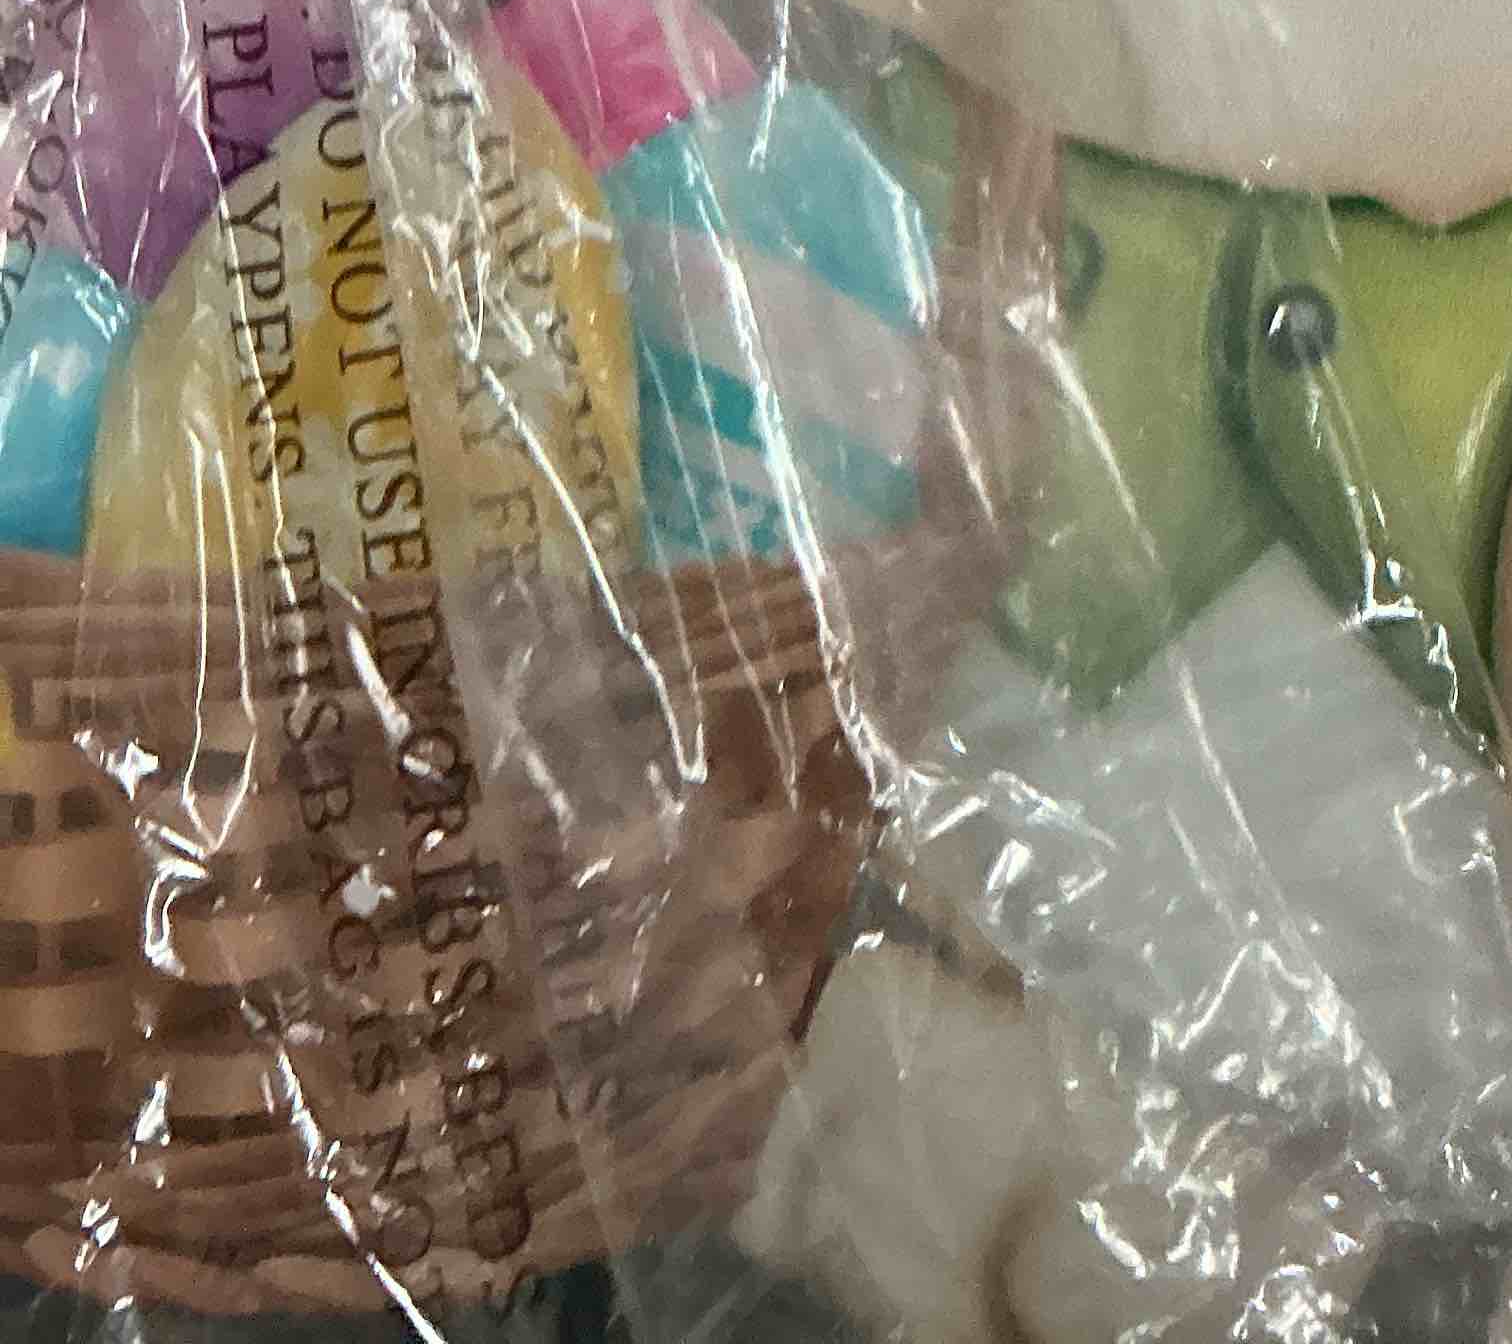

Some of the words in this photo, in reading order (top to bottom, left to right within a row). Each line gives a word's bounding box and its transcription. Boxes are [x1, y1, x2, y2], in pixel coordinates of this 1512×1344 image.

[310, 48, 367, 172] DO
[200, 15, 307, 510] PLAYPENS.
[321, 199, 404, 379] NOT
[346, 402, 433, 576] USE
[262, 529, 344, 745] THIS
[371, 593, 461, 703] IN
[296, 779, 387, 982] BAG
